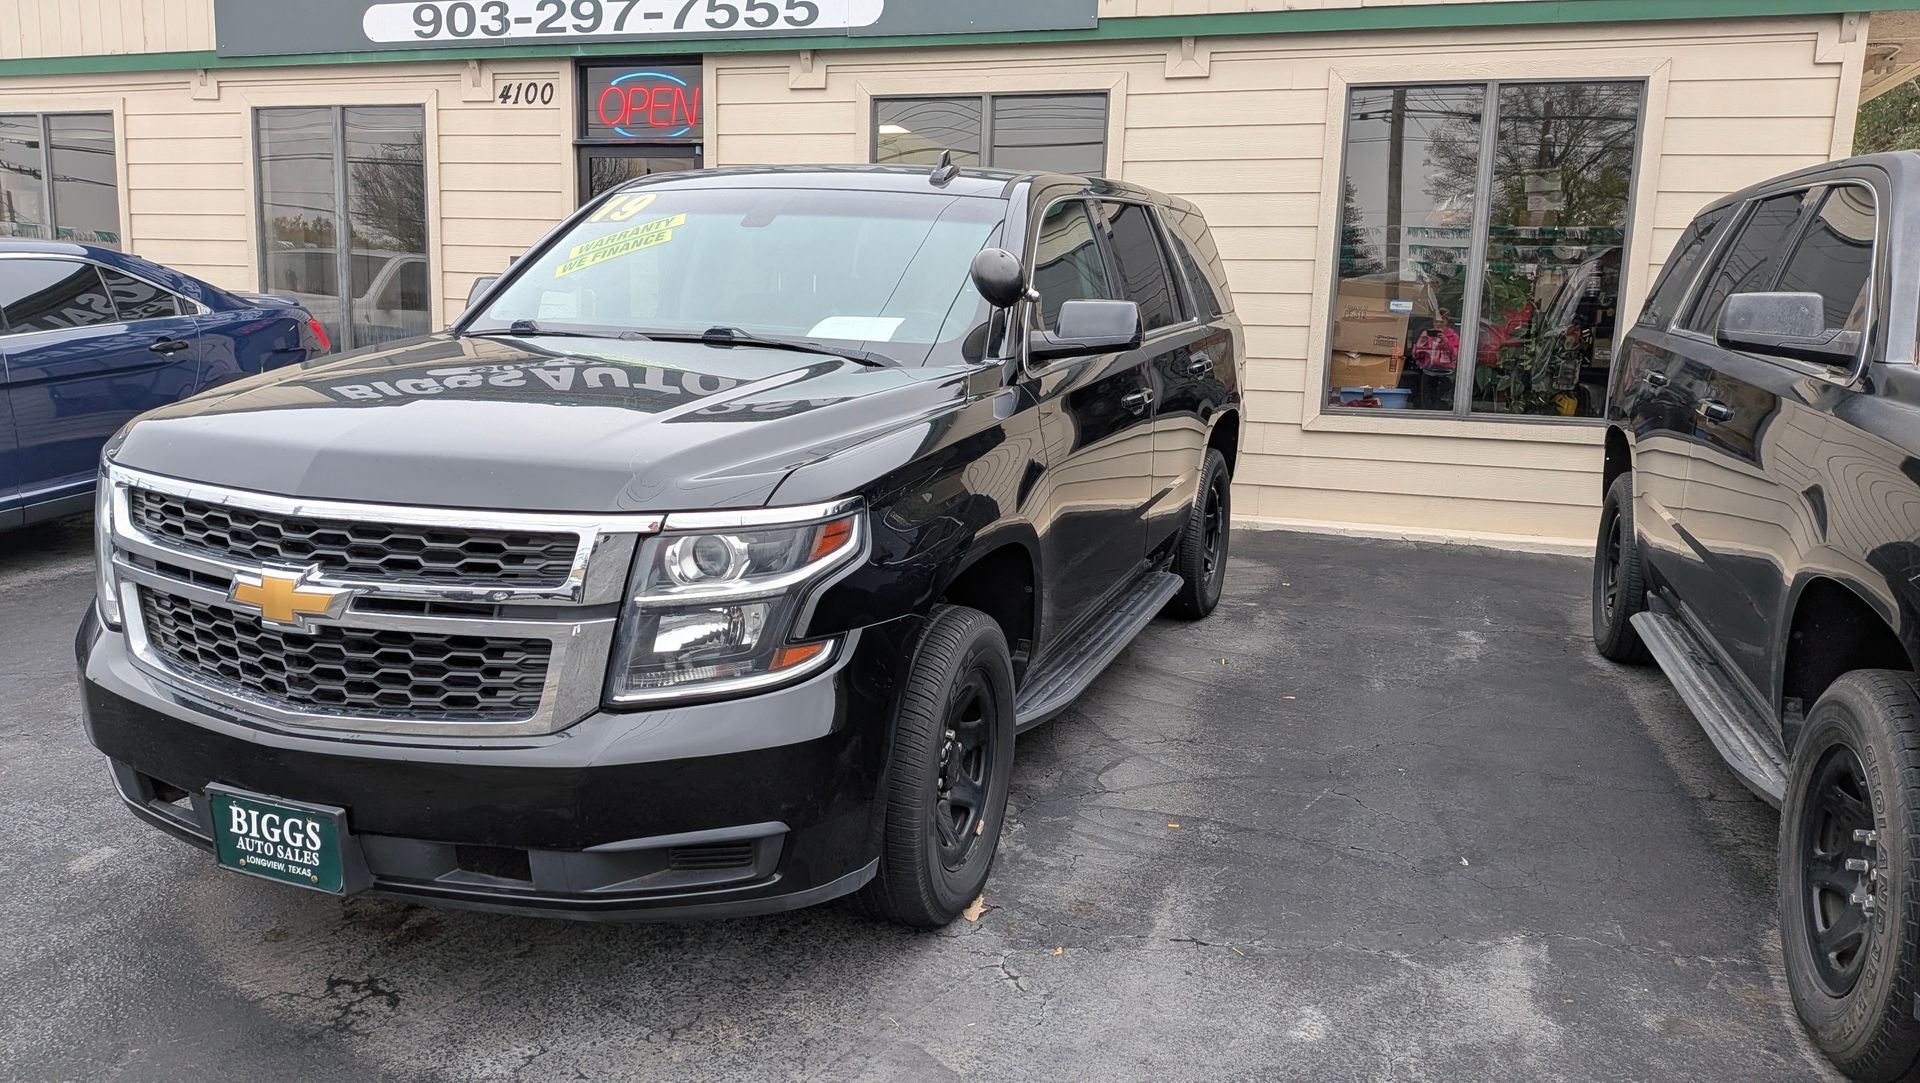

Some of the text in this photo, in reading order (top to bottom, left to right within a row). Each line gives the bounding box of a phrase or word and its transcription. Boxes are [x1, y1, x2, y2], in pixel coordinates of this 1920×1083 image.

[412, 0, 820, 39] 903-297-7555
[499, 82, 554, 105] 4100
[599, 86, 699, 126] OPEN
[590, 193, 657, 222] 19
[562, 231, 667, 273] WE FINANCE
[578, 217, 675, 255] WARRANTY
[229, 805, 321, 851] BIGGS
[236, 836, 320, 866] AUTO SALES
[246, 855, 312, 877] LONGVIEW, TEXAS
